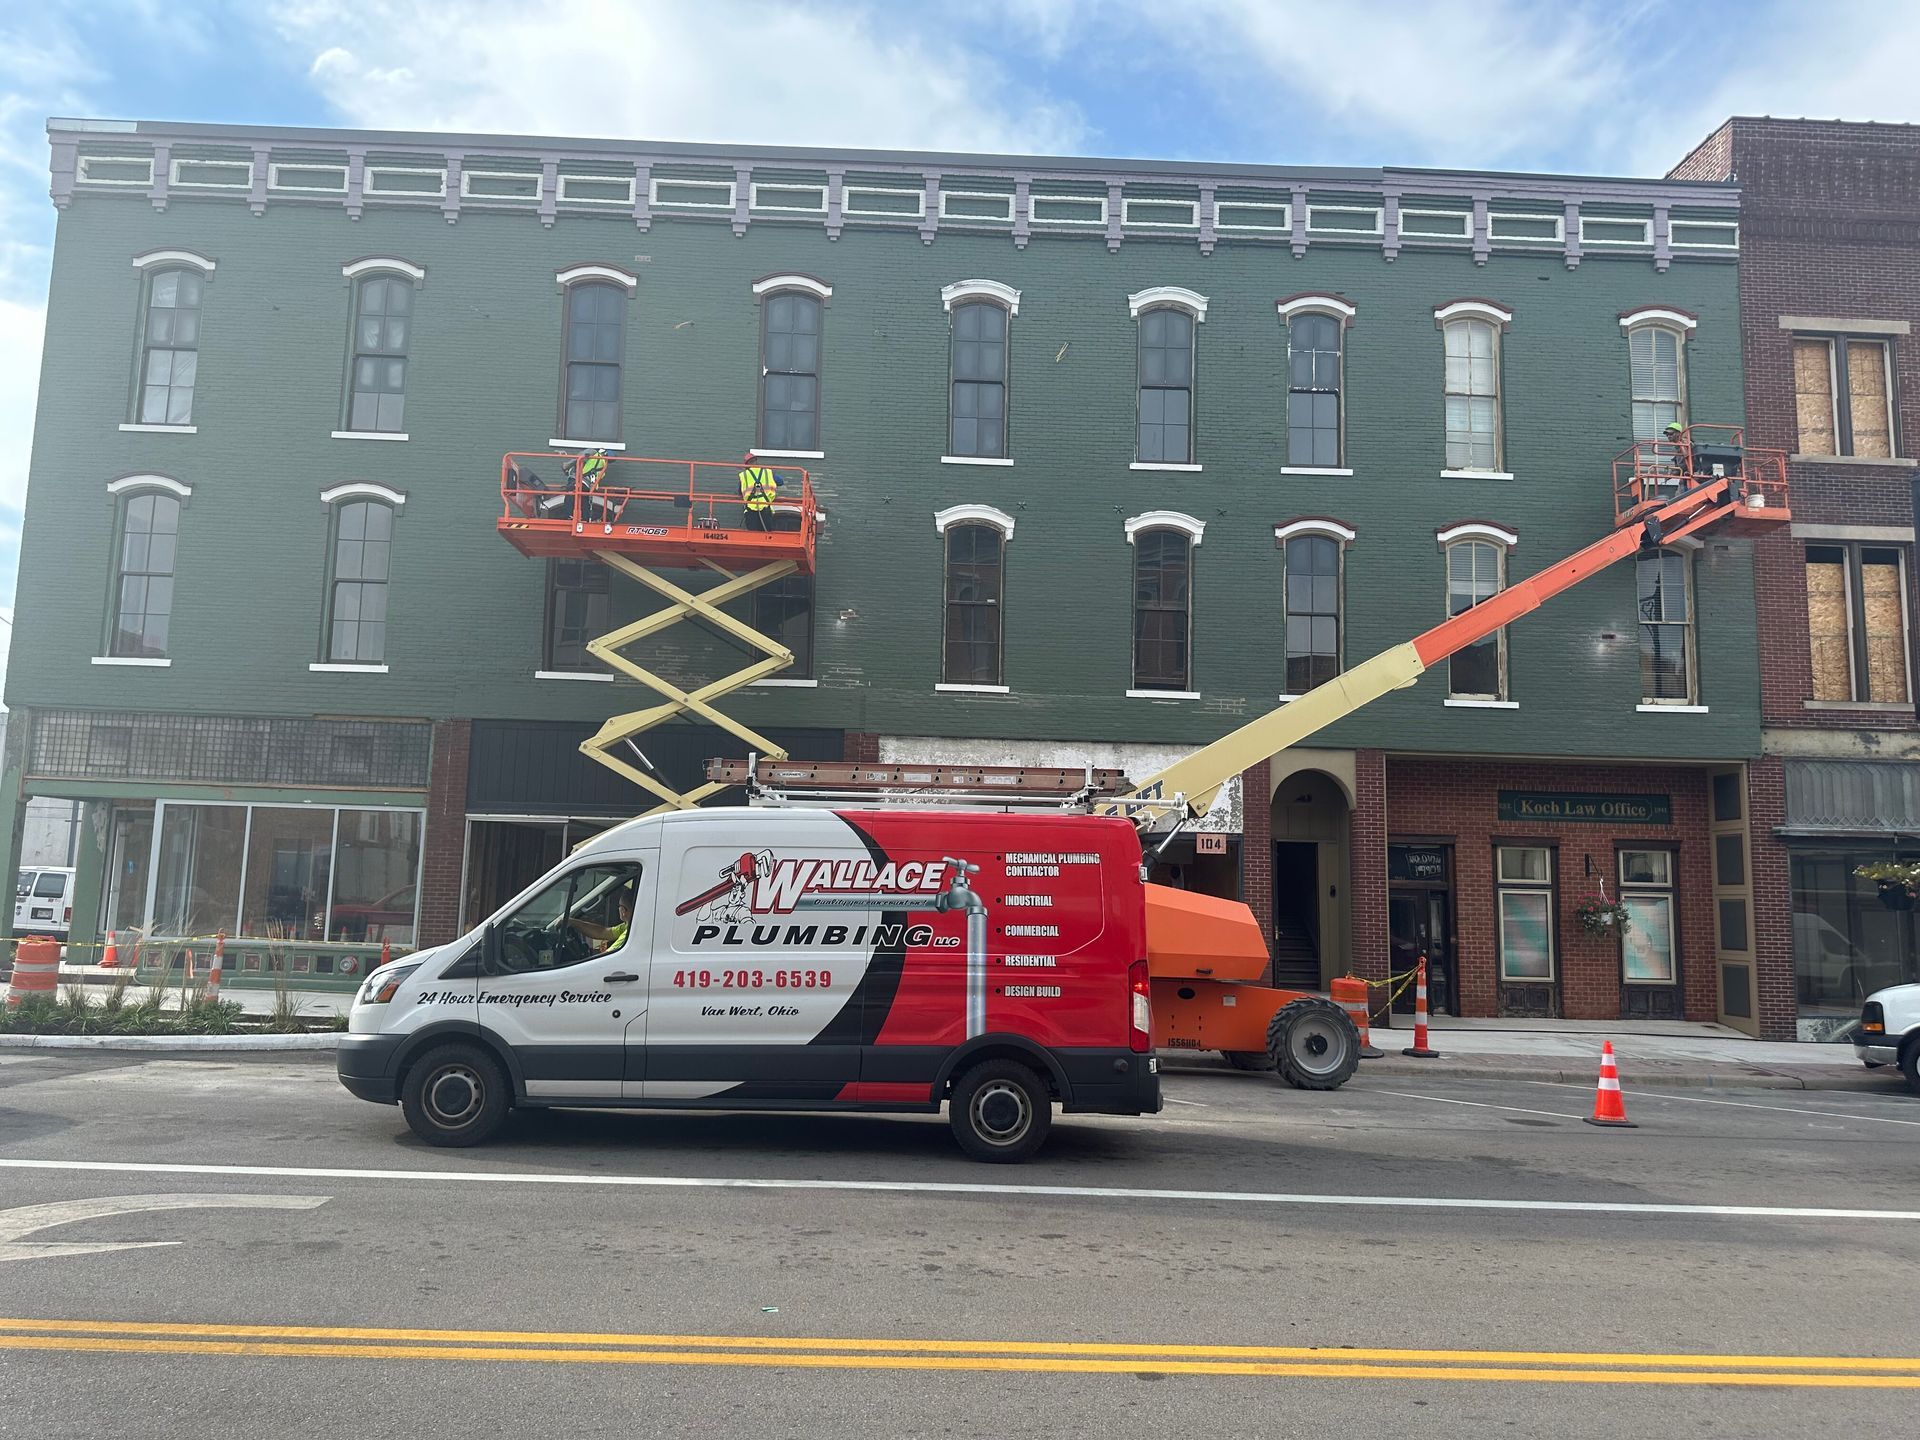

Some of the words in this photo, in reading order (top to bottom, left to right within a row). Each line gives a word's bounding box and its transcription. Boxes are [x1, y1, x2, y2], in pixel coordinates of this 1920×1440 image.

[626, 527, 669, 536] RT4069
[1521, 800, 1560, 814] Koch
[1565, 802, 1596, 815] Law
[1601, 802, 1647, 816] Office
[1201, 838, 1221, 849] 104
[1005, 853, 1057, 864] MECHANICAL
[1058, 853, 1100, 864] PLUMBING
[1005, 866, 1060, 877] CONTRACTOR
[752, 859, 948, 914] WALLACE
[1005, 895, 1053, 907] INDUSTRIAL
[690, 924, 933, 947] PLUMBING
[934, 936, 960, 947] LLC
[1005, 925, 1060, 937] COMMERCIAL
[1005, 955, 1057, 967] RESIDENTIAL
[673, 970, 832, 988] 419-203-6539
[1004, 986, 1035, 997] DESIGN
[1036, 986, 1061, 998] BUILD
[417, 992, 437, 1005] 24
[439, 992, 475, 1005] Hour
[477, 991, 557, 1007] Emergency
[558, 990, 612, 1003] Service
[701, 1006, 726, 1017] Van
[729, 1005, 763, 1017] Wert,
[767, 1005, 799, 1016] Ohio
